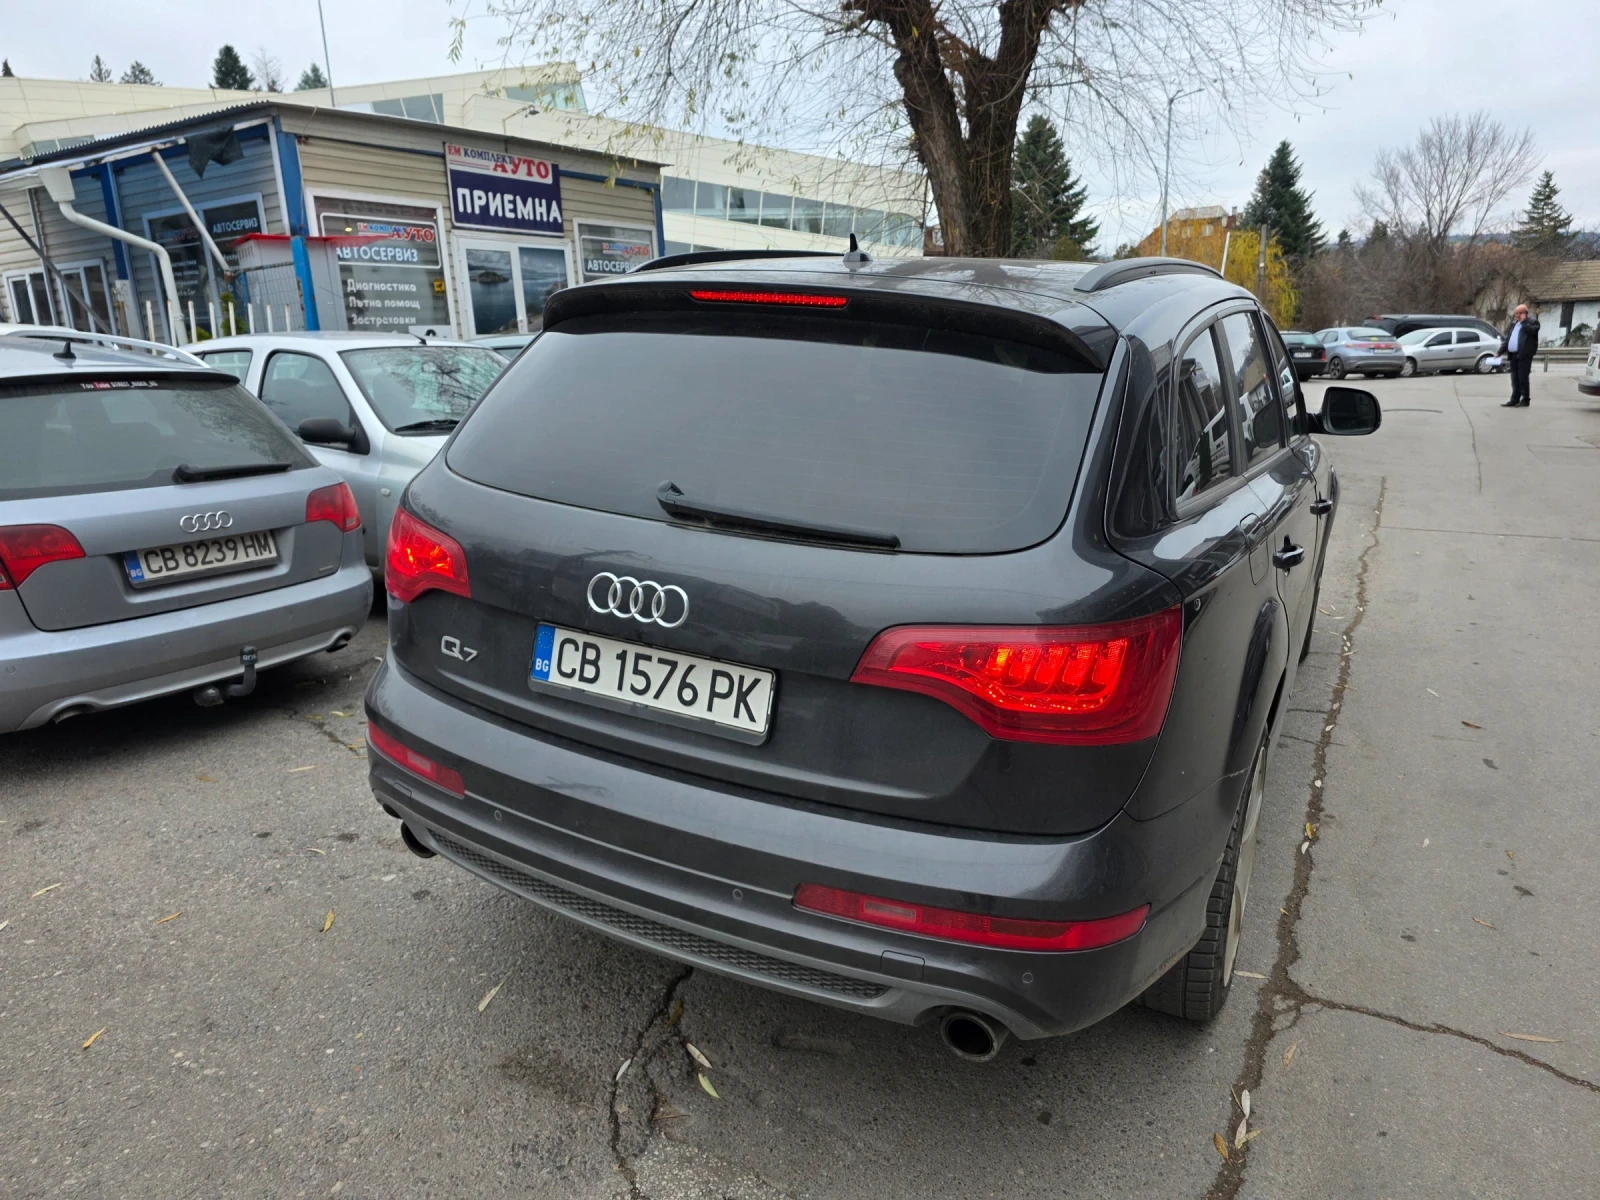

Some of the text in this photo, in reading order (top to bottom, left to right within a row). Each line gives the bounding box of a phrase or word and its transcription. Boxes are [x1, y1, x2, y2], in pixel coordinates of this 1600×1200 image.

[463, 148, 513, 164] КОМПЛЕКТ
[492, 157, 550, 179] АУТО
[456, 187, 562, 223] ПРИЕМНА
[212, 217, 258, 234] АВТОСЕРВИЗ
[390, 226, 434, 242] АУТО
[336, 246, 418, 262] АВТОСЕРВИЗ
[587, 259, 636, 272] АВТОСЕРВИ
[347, 279, 416, 293] Диагностика
[349, 297, 420, 309] Пътна помощ
[351, 314, 416, 327] Застраховки
[143, 532, 272, 574] CB 8239 HM
[130, 569, 142, 577] BG
[441, 635, 477, 662] Q7
[535, 658, 549, 673] BG
[556, 638, 762, 723] CB 1576 PK
